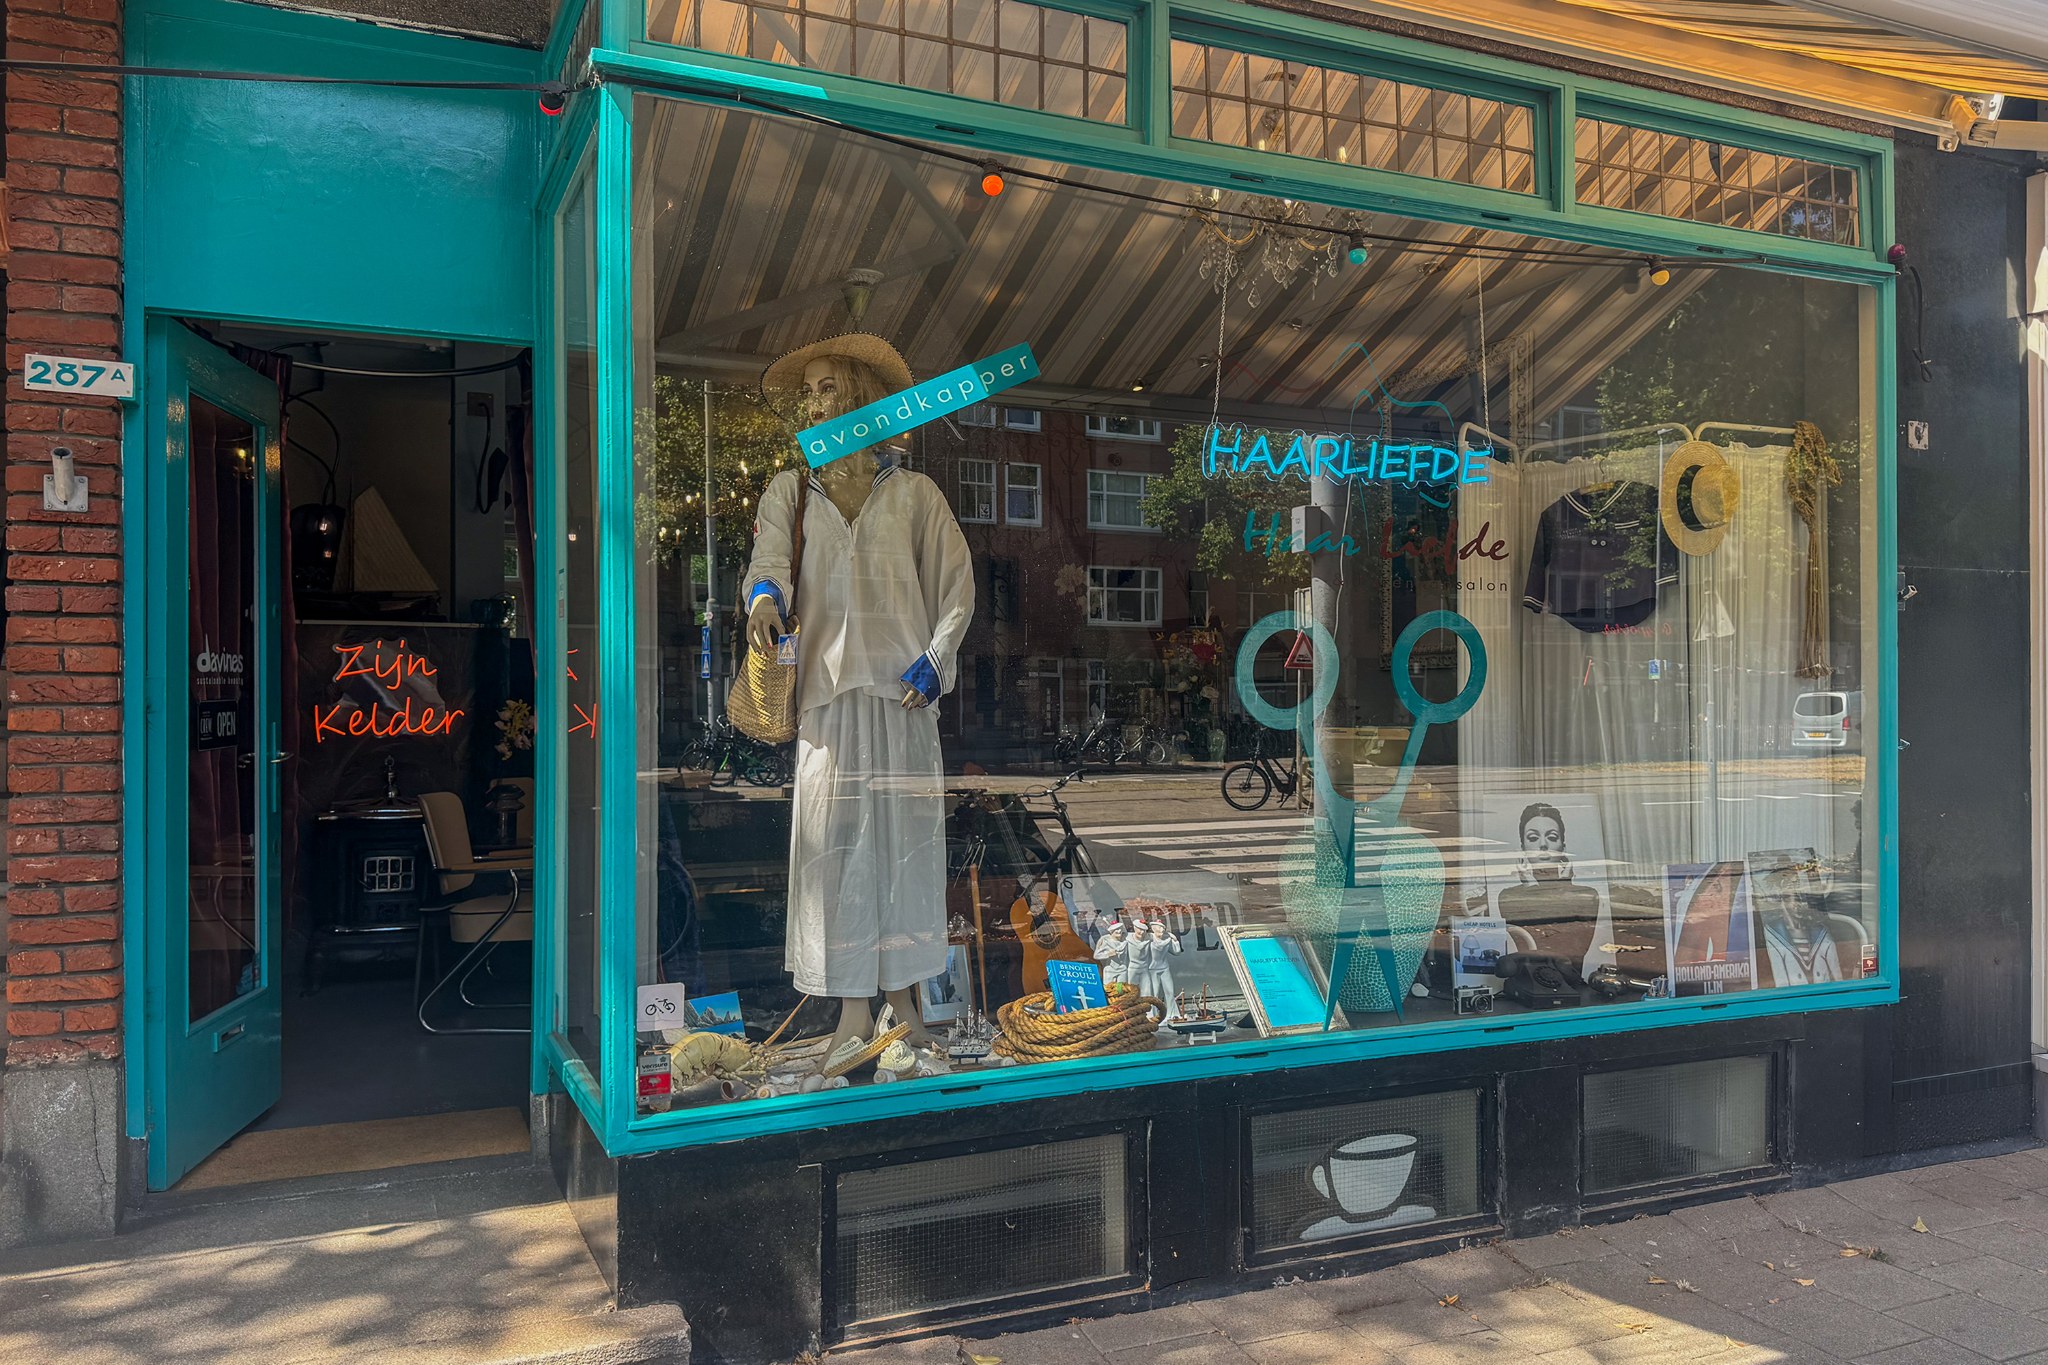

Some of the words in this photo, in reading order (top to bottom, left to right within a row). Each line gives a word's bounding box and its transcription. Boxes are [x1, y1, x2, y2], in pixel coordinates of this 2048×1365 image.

[810, 354, 1028, 455] avondkapper
[1208, 428, 1491, 484] HAARLIEFDE
[1243, 510, 1361, 558] Haar
[1379, 515, 1510, 575] Liefde
[196, 633, 244, 673] davines
[335, 639, 438, 690] Zijn
[216, 711, 236, 737] OPEN
[314, 696, 465, 743] Kelder
[1059, 970, 1096, 980] GROULT
[1674, 961, 1750, 982] HOLLAND-AMERIKA
